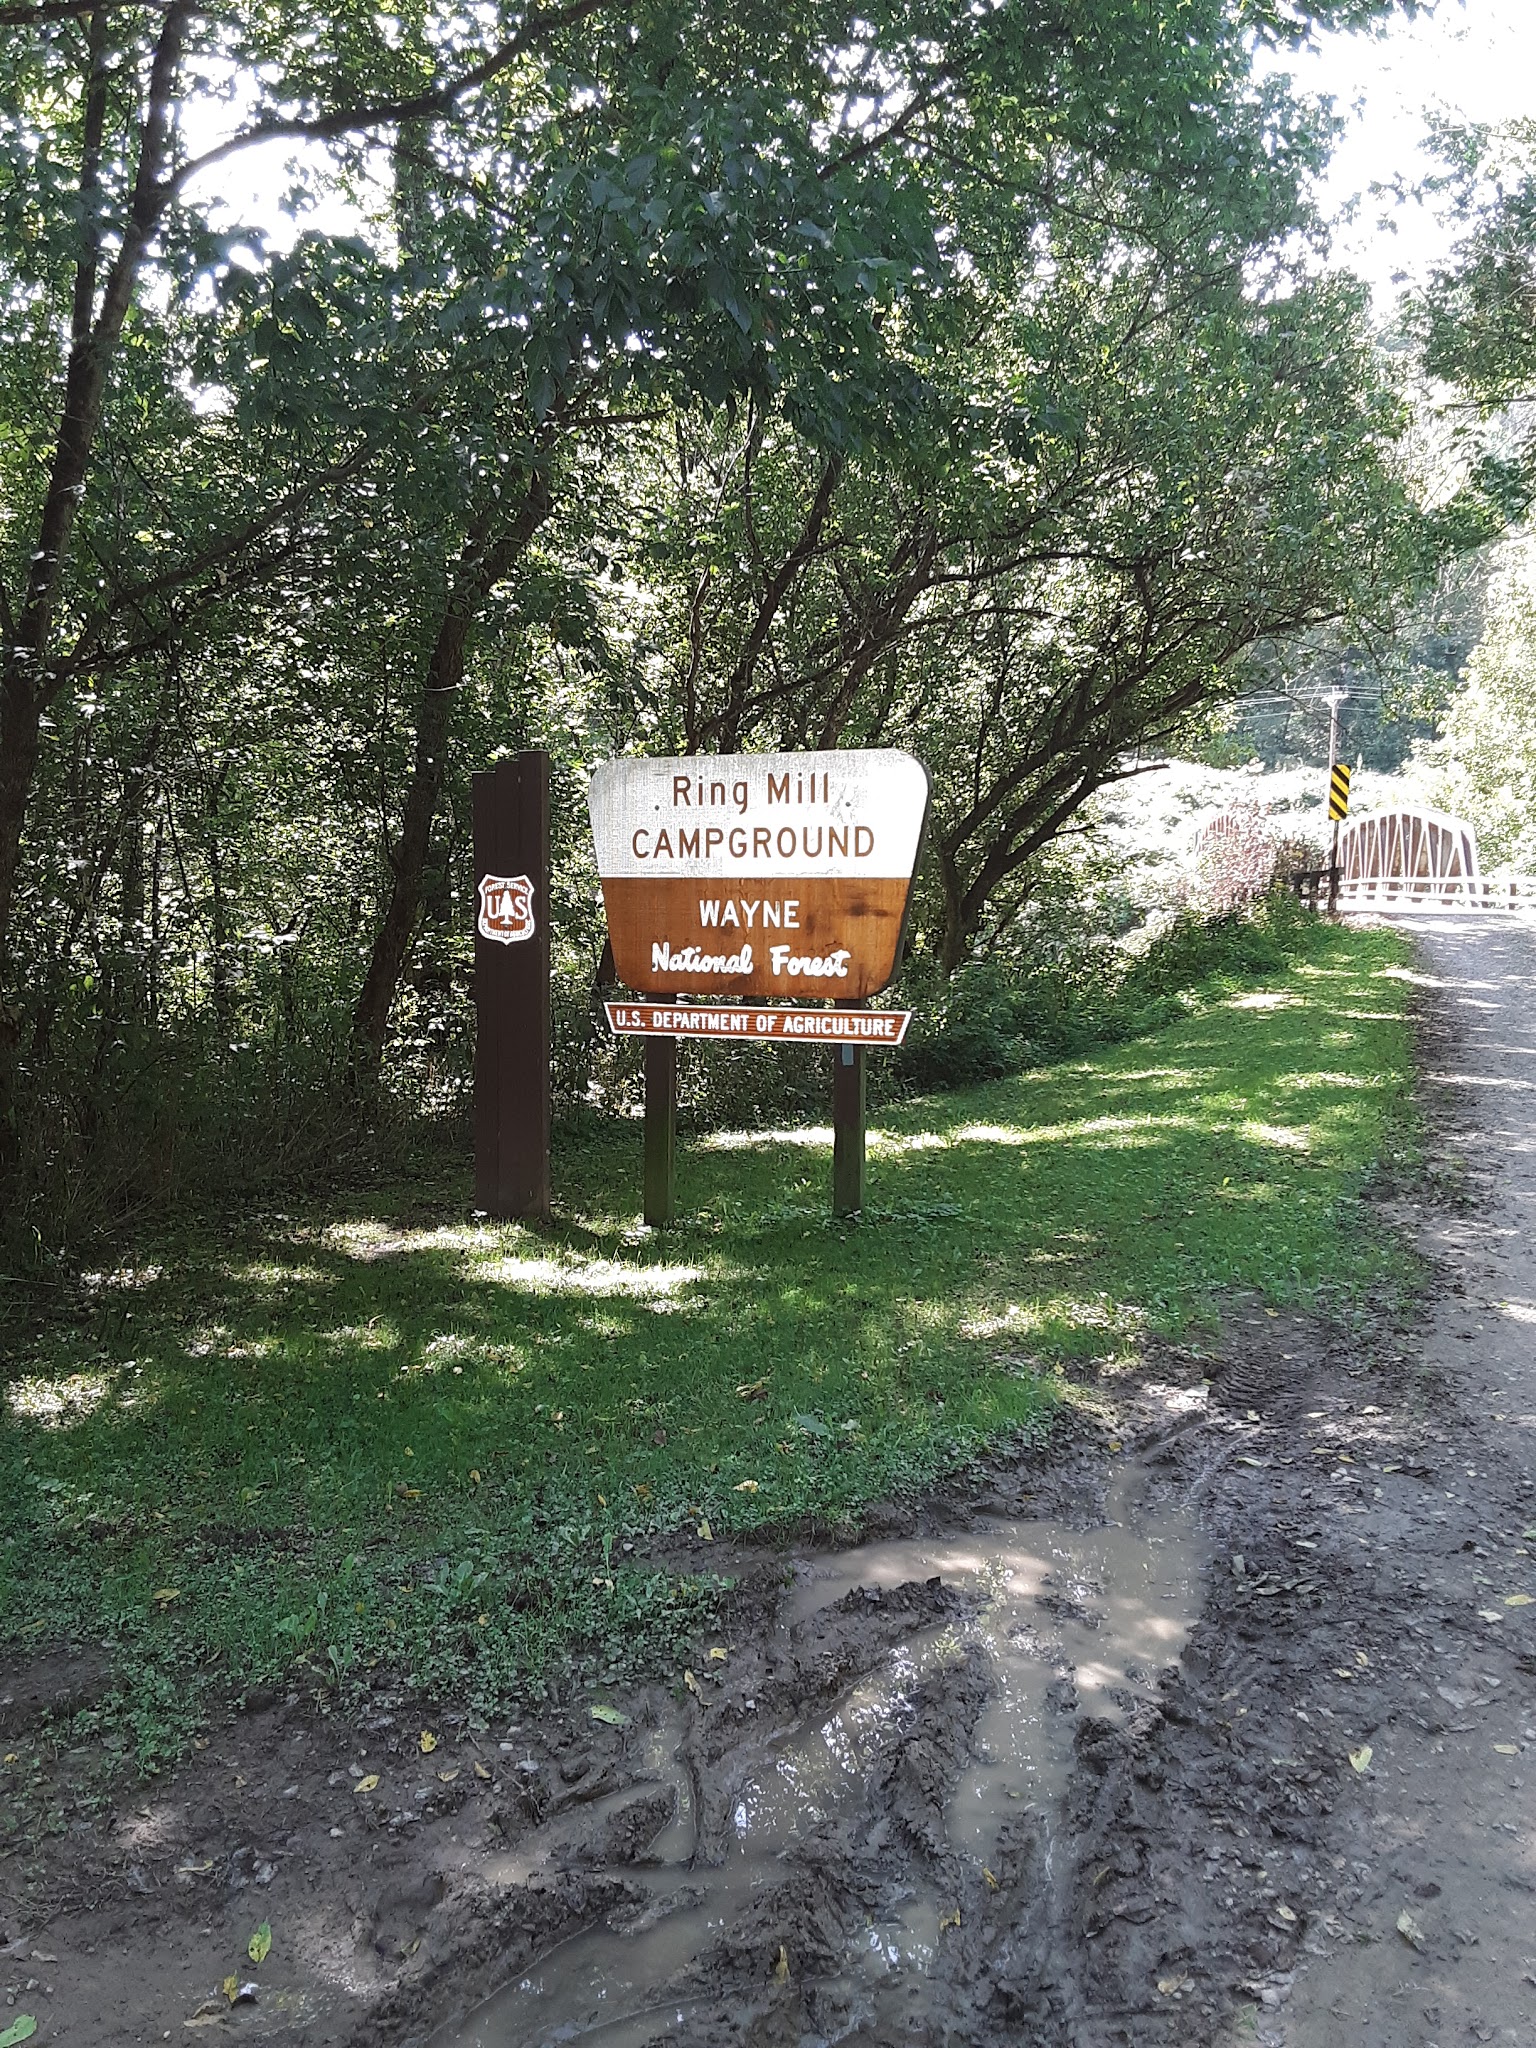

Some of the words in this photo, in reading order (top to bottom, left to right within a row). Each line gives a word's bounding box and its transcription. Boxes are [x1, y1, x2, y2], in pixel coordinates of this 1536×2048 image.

[673, 775, 749, 814] Ring
[767, 771, 830, 804] Mill
[632, 826, 875, 859] CAMPGROUND
[699, 900, 801, 929] WAYNE
[651, 942, 753, 975] National
[769, 944, 852, 978] Forest
[616, 1010, 646, 1028] U.S.
[652, 1012, 750, 1032] DEPARTMENT
[756, 1015, 777, 1032] OF
[783, 1016, 897, 1038] AGRICULTURE
